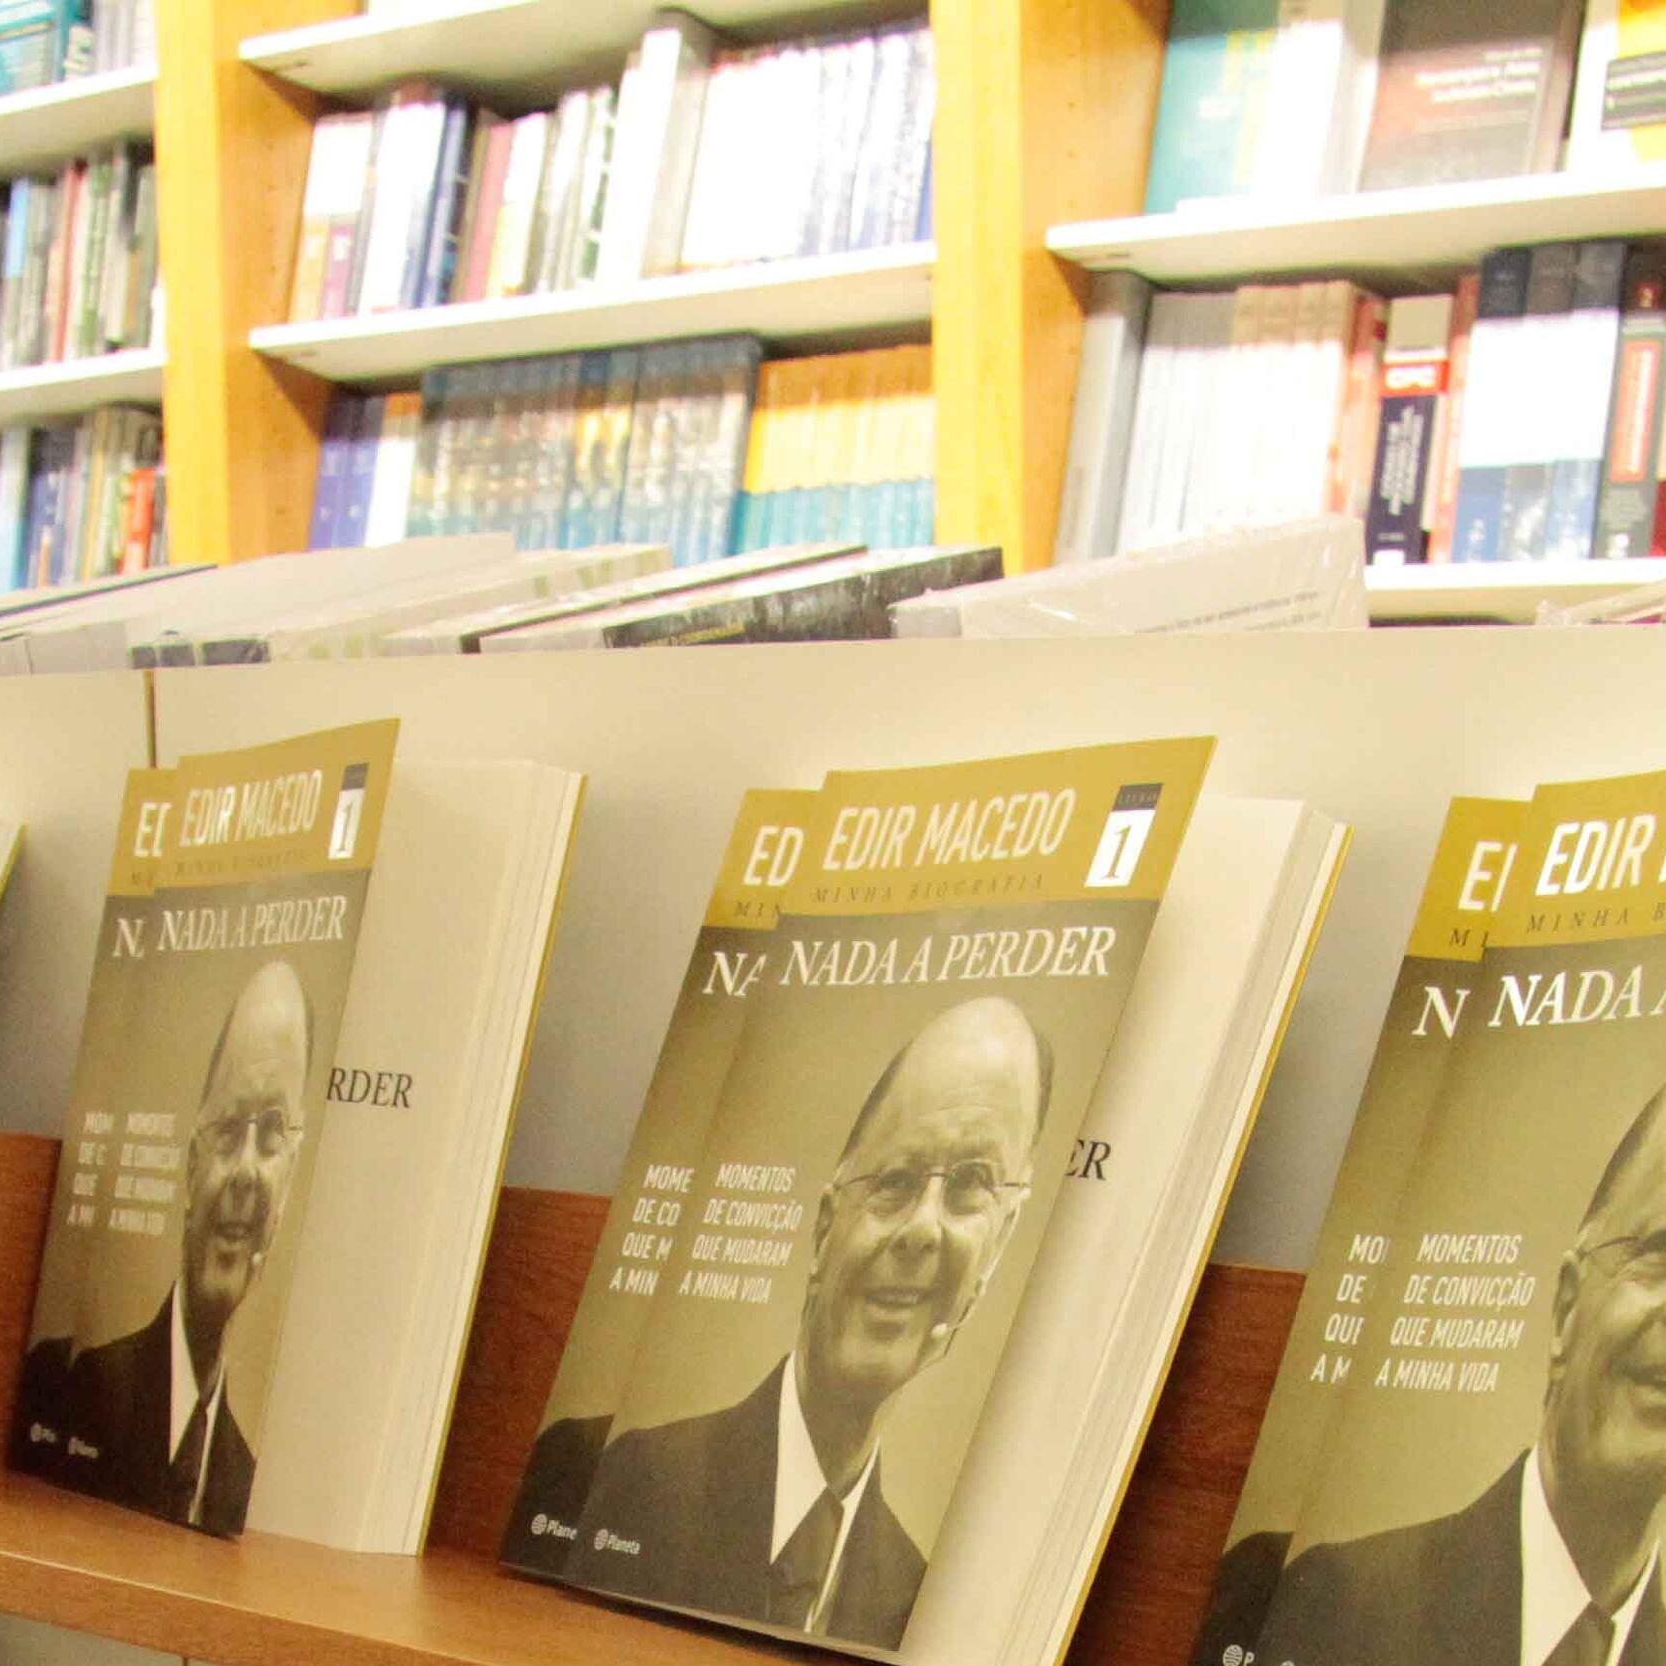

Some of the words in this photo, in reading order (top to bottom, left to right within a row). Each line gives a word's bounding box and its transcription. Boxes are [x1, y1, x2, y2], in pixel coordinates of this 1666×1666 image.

[180, 787, 234, 848] EDIR
[234, 768, 323, 842] MACEDO
[334, 800, 354, 853] 1
[822, 806, 916, 872] EDIR
[915, 787, 1077, 867] MACEDO
[1102, 824, 1133, 880] 1
[1534, 814, 1655, 897] EDIR
[811, 885, 894, 905] MINHA
[907, 872, 1045, 902] BIOGRAFIA
[156, 908, 229, 953] NADA
[233, 904, 251, 948] A
[251, 894, 348, 949] PERDER
[1525, 908, 1632, 935] MINHA
[779, 938, 898, 987] NADA
[903, 936, 932, 984] A
[934, 926, 1118, 981] PERDER
[1487, 957, 1644, 1029] NADA
[715, 1162, 796, 1194] MOMENTOS
[632, 1197, 656, 1224] DE
[702, 1198, 726, 1225] DE
[621, 1231, 655, 1260] QUE
[691, 1234, 724, 1262] QUE
[722, 1237, 793, 1267] MUDARAM
[1417, 1233, 1523, 1264] MOMENTOS
[609, 1266, 622, 1290] A
[678, 1269, 692, 1296] A
[692, 1271, 739, 1300] MINHA
[740, 1277, 772, 1305] VIDA
[1336, 1273, 1367, 1304] DE
[1403, 1274, 1432, 1305] DE
[1390, 1316, 1430, 1348] QUE
[1430, 1317, 1525, 1351] MUDARAM
[1310, 1353, 1327, 1383] A
[1375, 1358, 1391, 1388] A
[1393, 1360, 1454, 1392] MINHA
[1457, 1362, 1501, 1393] VIDA
